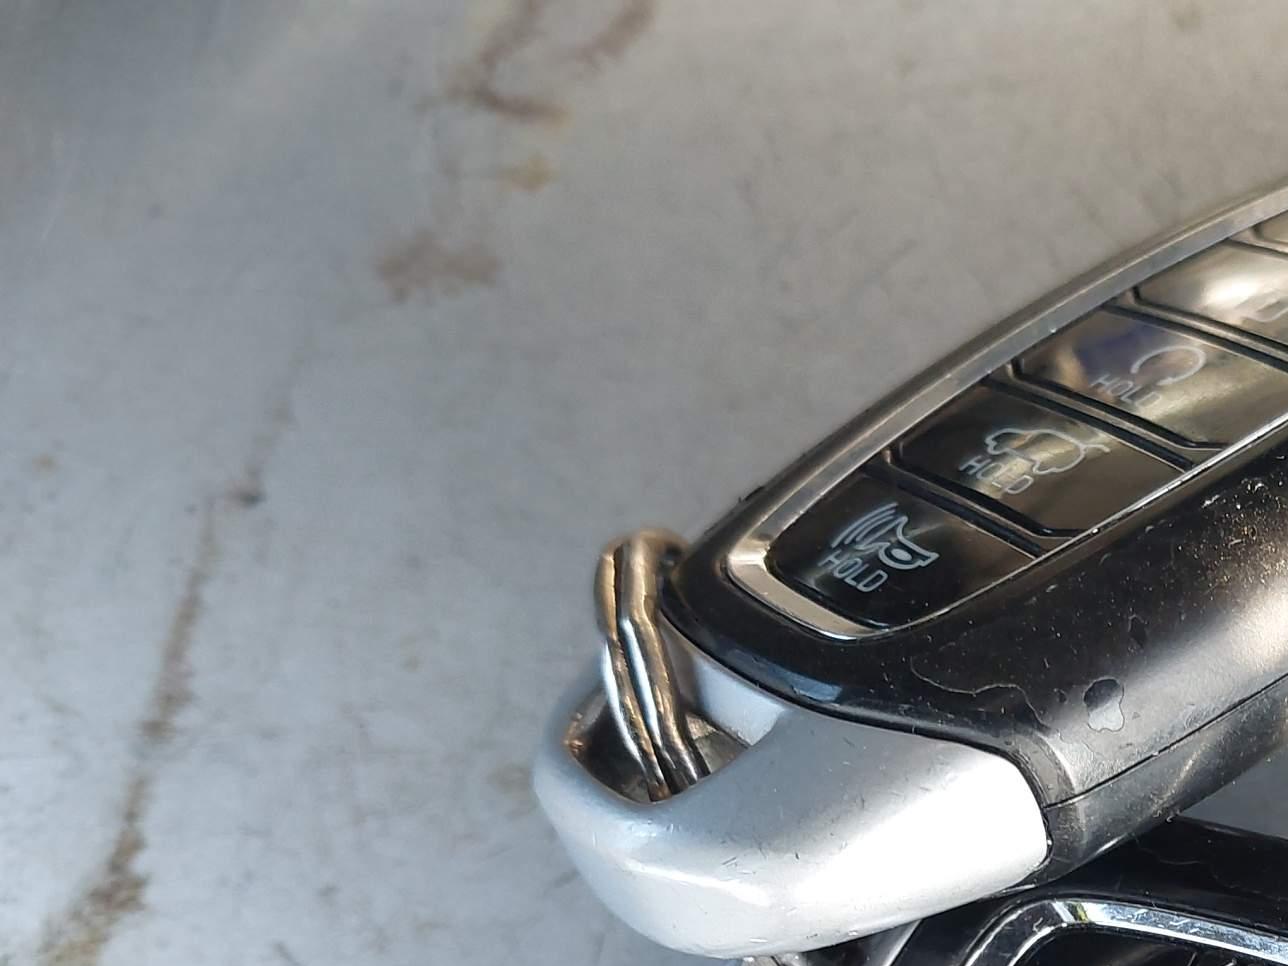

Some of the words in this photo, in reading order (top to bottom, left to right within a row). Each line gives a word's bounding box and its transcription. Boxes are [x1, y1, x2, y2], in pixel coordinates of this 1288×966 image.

[1090, 373, 1161, 408] HOLD
[959, 455, 1034, 494] HOLD
[817, 550, 888, 592] HOLD
